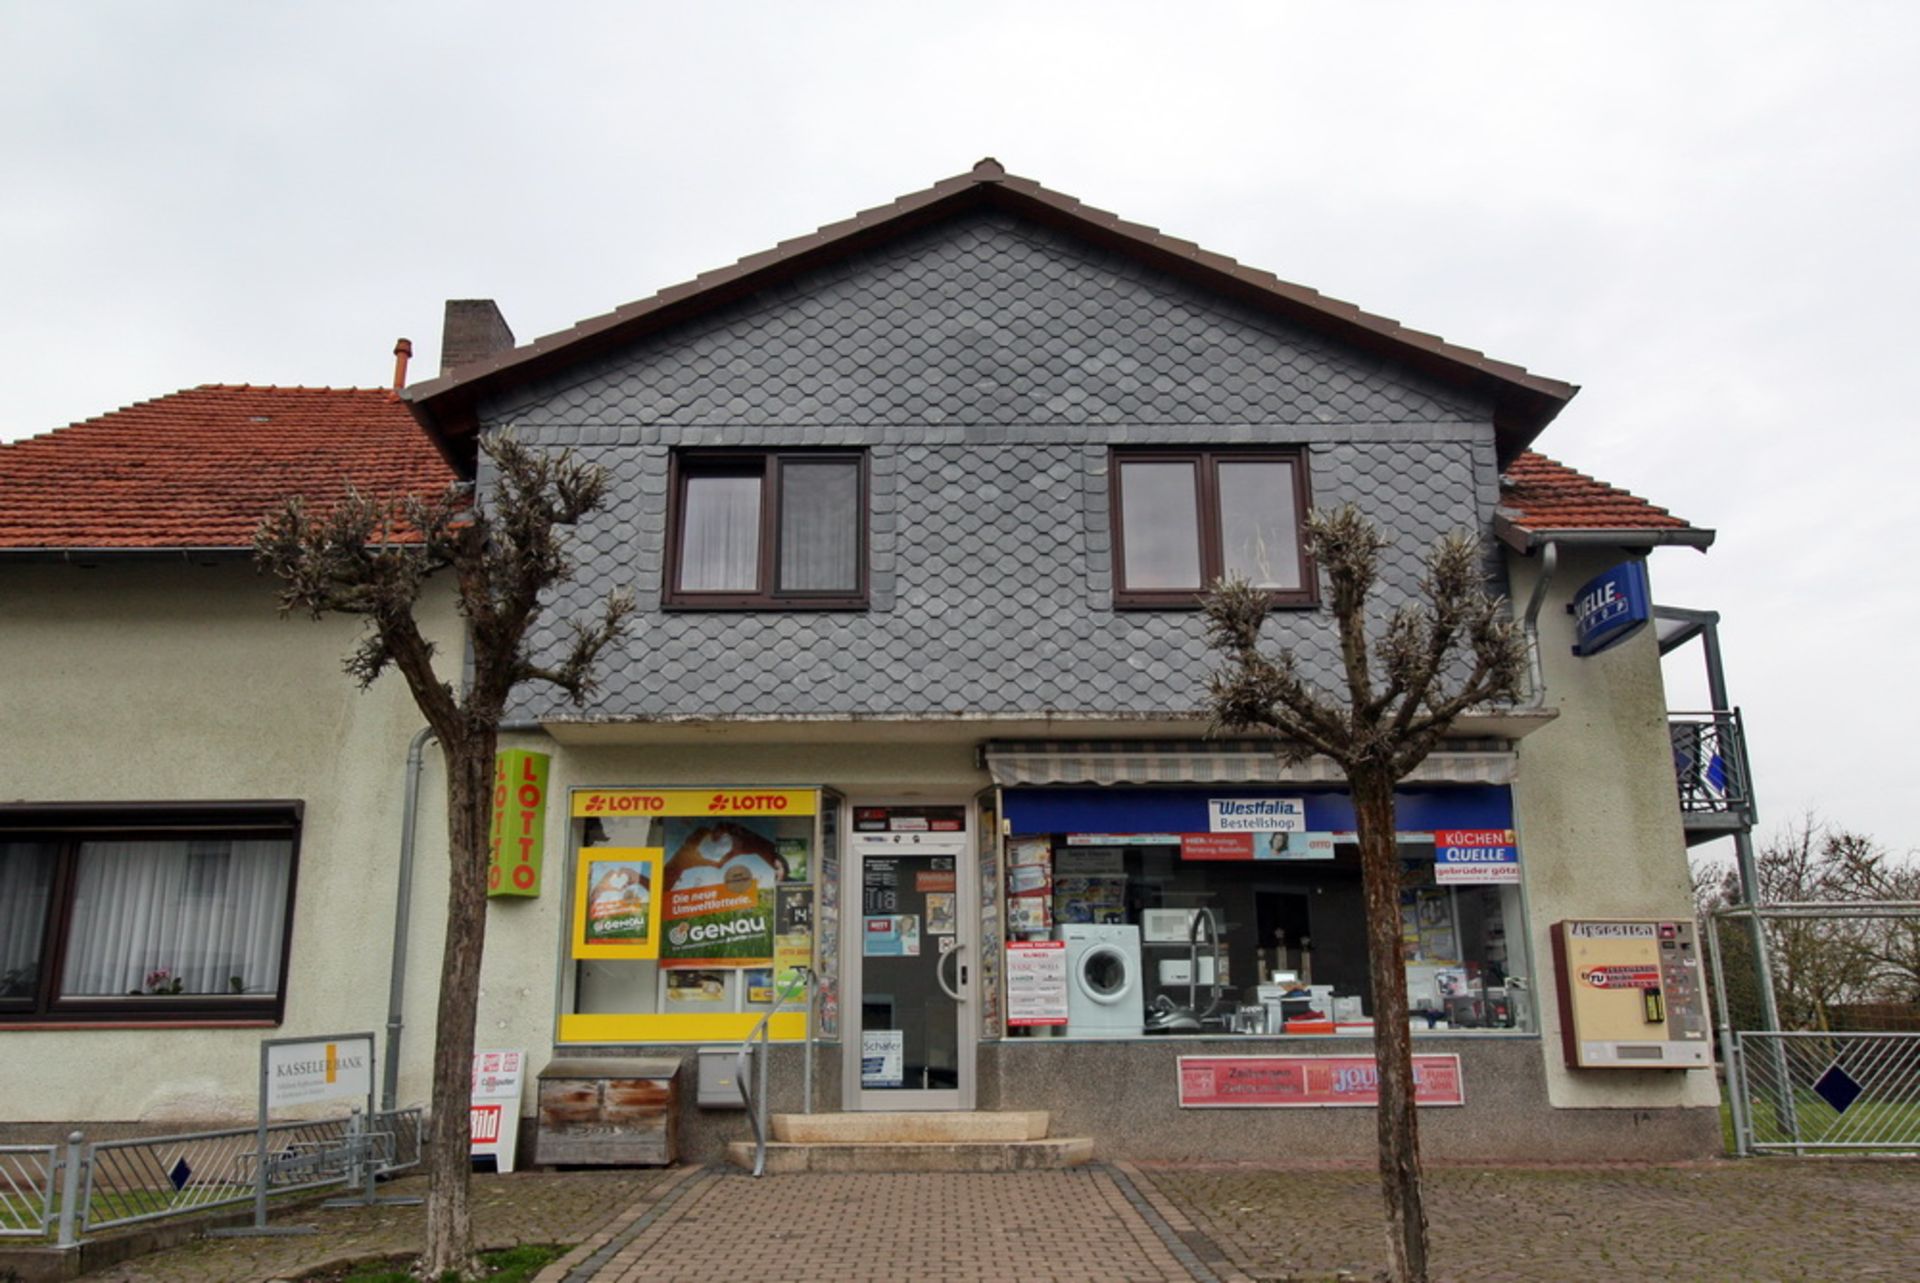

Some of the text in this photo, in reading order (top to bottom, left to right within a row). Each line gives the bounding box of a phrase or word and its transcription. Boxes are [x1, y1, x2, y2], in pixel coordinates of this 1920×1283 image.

[1577, 581, 1616, 620] UELLE
[608, 797, 664, 811] LOTTO
[732, 796, 788, 810] LOTTO
[1213, 800, 1301, 815] Westfalia
[511, 757, 541, 890] LOTTO
[1220, 818, 1294, 831] Bestellshop
[1308, 840, 1332, 851] OTTO
[1445, 832, 1503, 846] KÜCHEN
[1446, 847, 1505, 862] QUELLE
[672, 891, 717, 904] Die neue
[277, 1056, 363, 1077] KASSELER BANK
